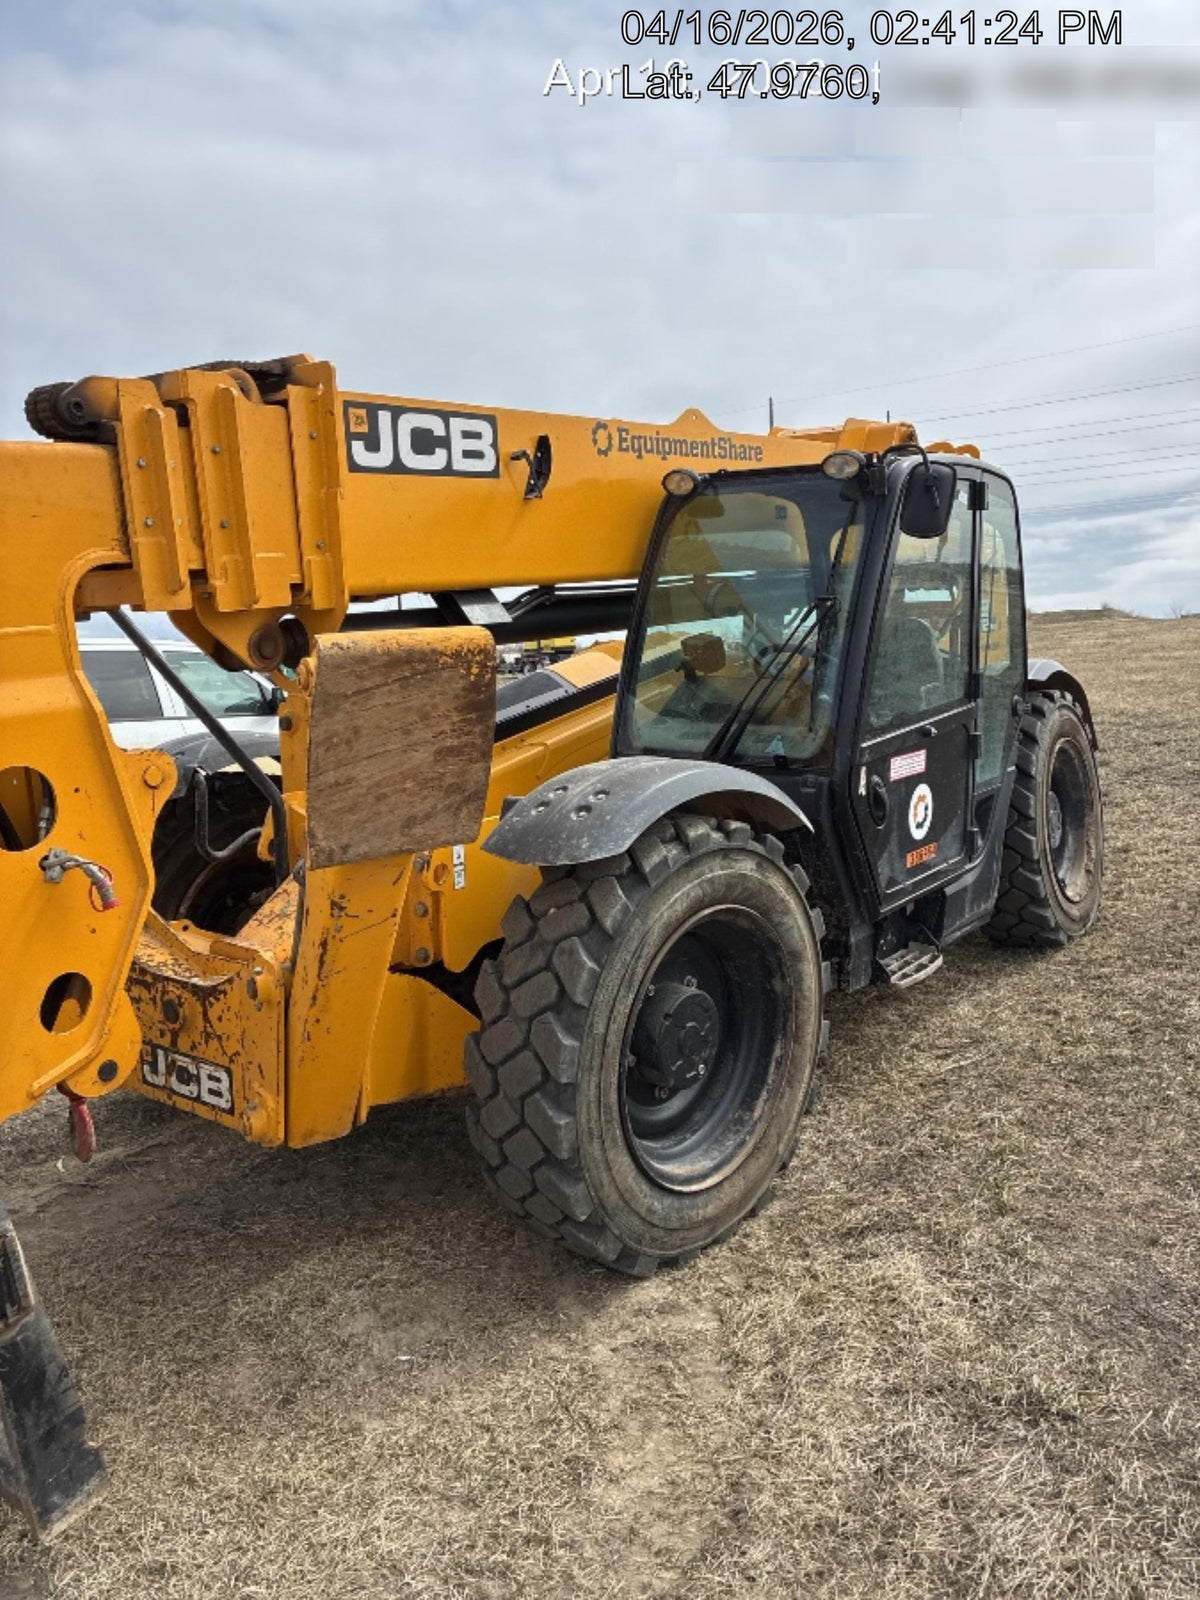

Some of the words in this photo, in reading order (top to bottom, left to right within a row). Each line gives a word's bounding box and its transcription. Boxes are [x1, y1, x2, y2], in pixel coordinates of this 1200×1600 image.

[350, 409, 497, 473] JCB
[616, 426, 763, 462] EquipmentShare
[143, 1048, 232, 1110] JCB
